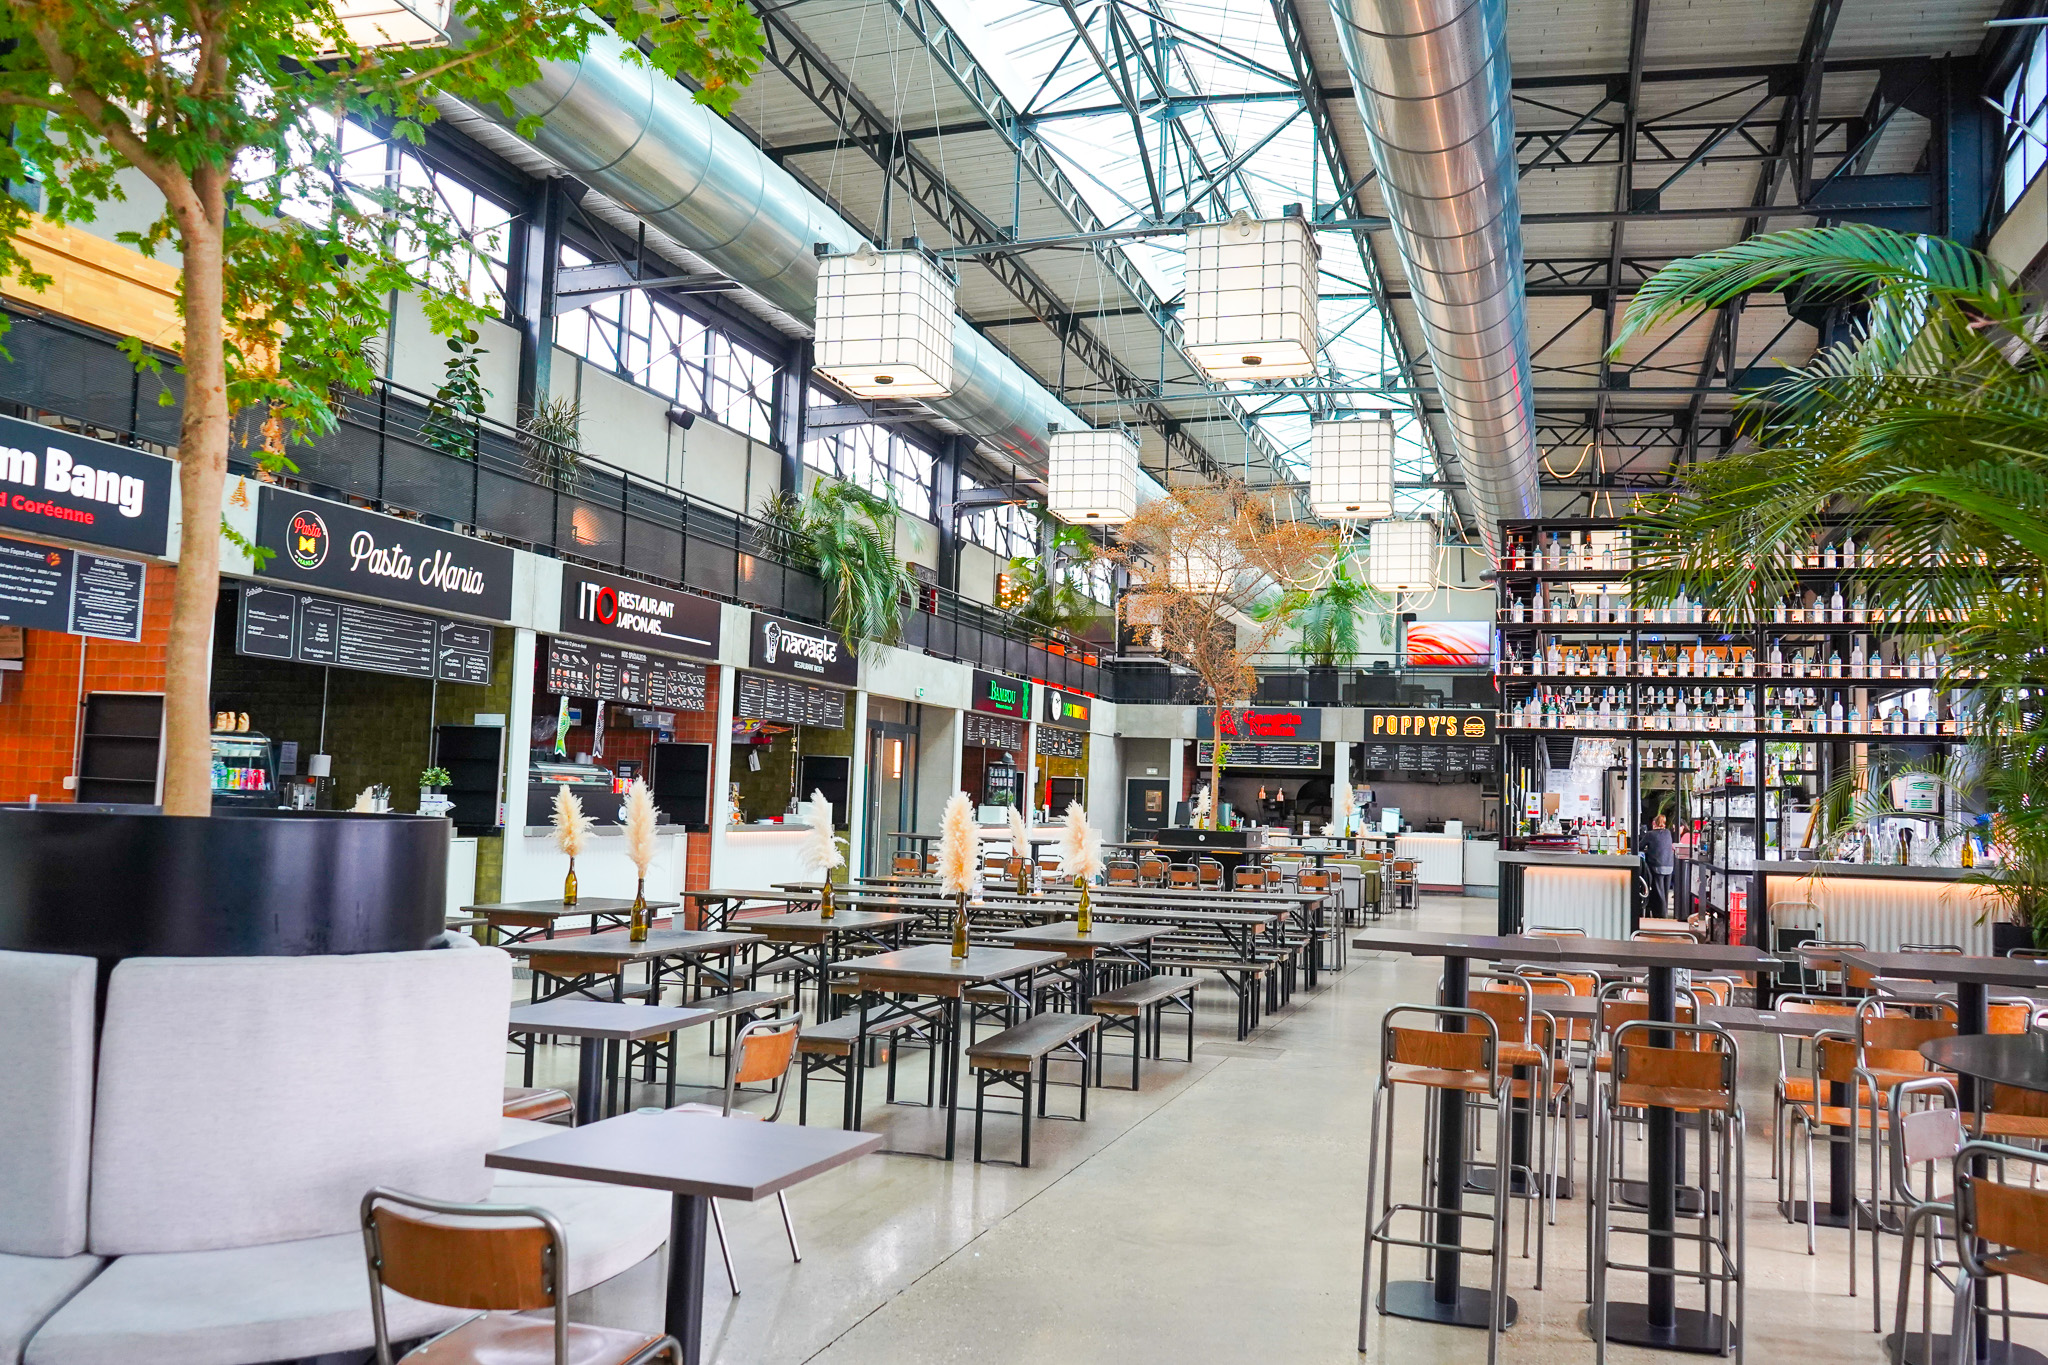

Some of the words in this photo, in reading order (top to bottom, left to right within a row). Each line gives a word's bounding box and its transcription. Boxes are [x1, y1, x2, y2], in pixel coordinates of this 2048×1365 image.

[44, 446, 145, 518] Bang
[11, 494, 95, 525] Coréenne
[293, 516, 322, 538] Pasta
[297, 556, 315, 566] MANIA
[350, 530, 414, 580] Pasta
[418, 549, 485, 595] Mania
[578, 580, 618, 625] ITO
[618, 590, 675, 618] RESTAURANT
[616, 611, 662, 635] JAPONAIS
[781, 629, 838, 664] namaste
[990, 680, 1016, 704] BAMBOU
[1373, 714, 1458, 737] POPPY'S
